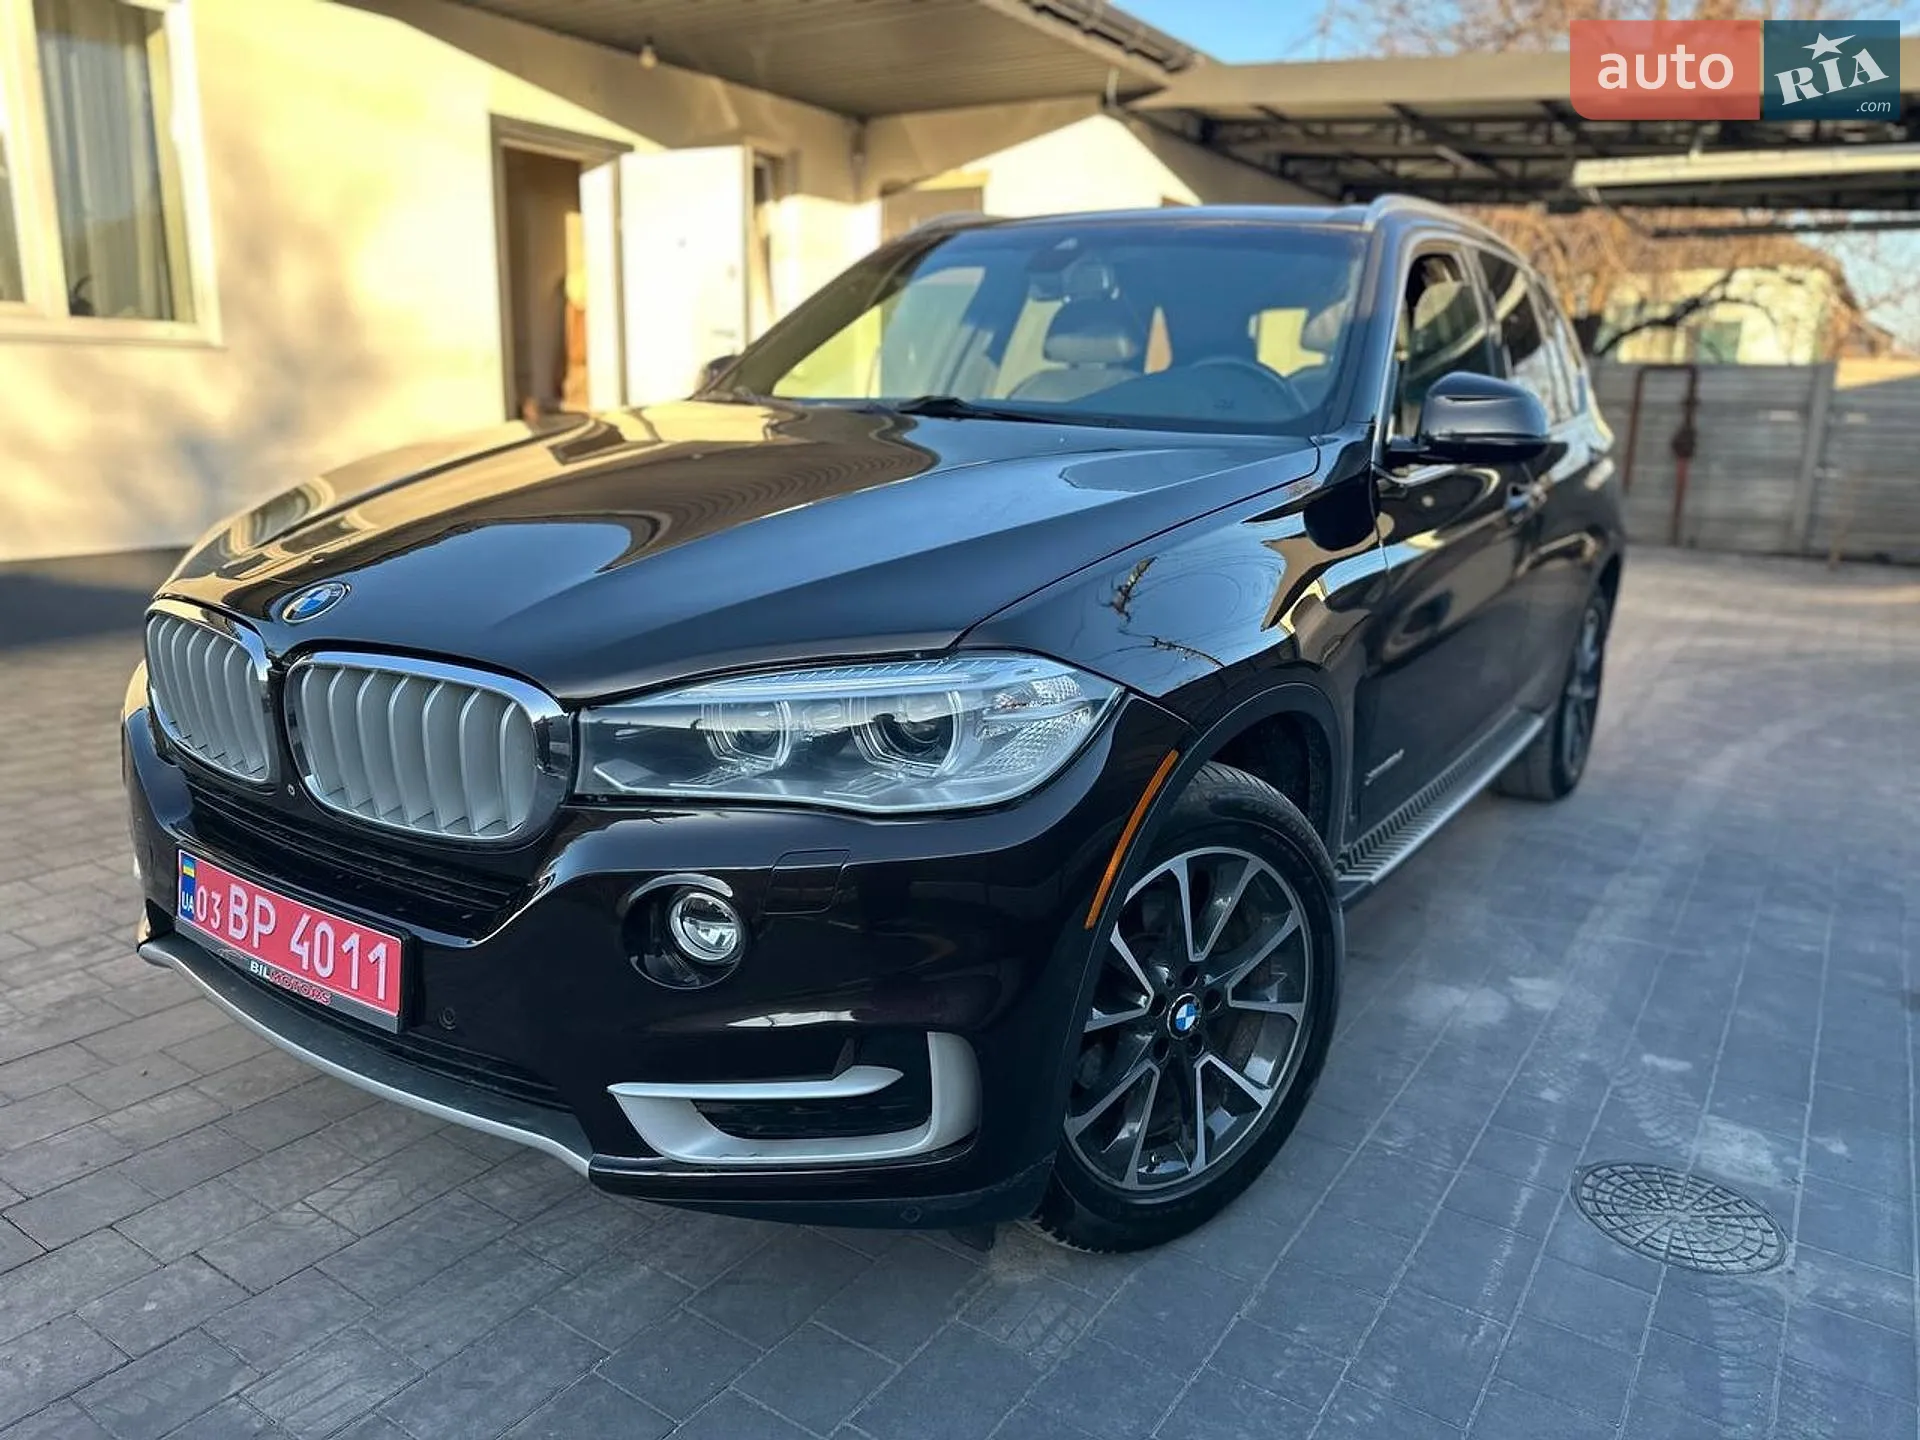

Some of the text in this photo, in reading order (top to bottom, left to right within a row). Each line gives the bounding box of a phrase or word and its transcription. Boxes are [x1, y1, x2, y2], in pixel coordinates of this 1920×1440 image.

[181, 890, 196, 915] UA
[196, 883, 388, 1001] 03 BP 4011
